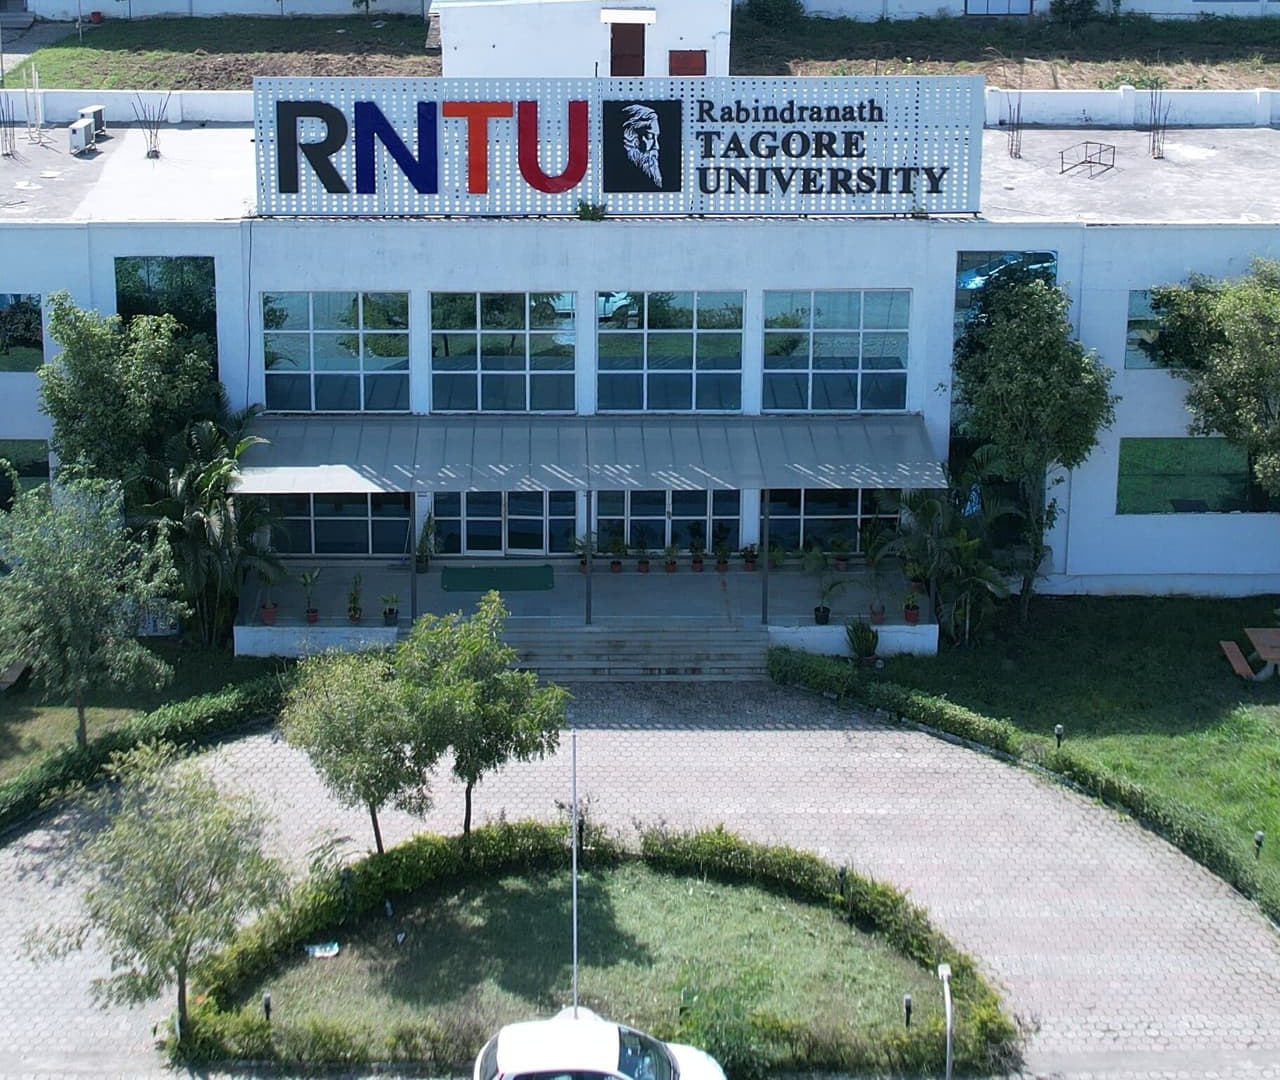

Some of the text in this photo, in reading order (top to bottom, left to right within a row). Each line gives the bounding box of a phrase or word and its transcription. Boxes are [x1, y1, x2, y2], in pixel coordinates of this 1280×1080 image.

[696, 99, 885, 123] Rabindranath
[276, 100, 589, 194] RNTU
[695, 131, 866, 159] TAGORE
[696, 167, 950, 195] UNIVERSITY
